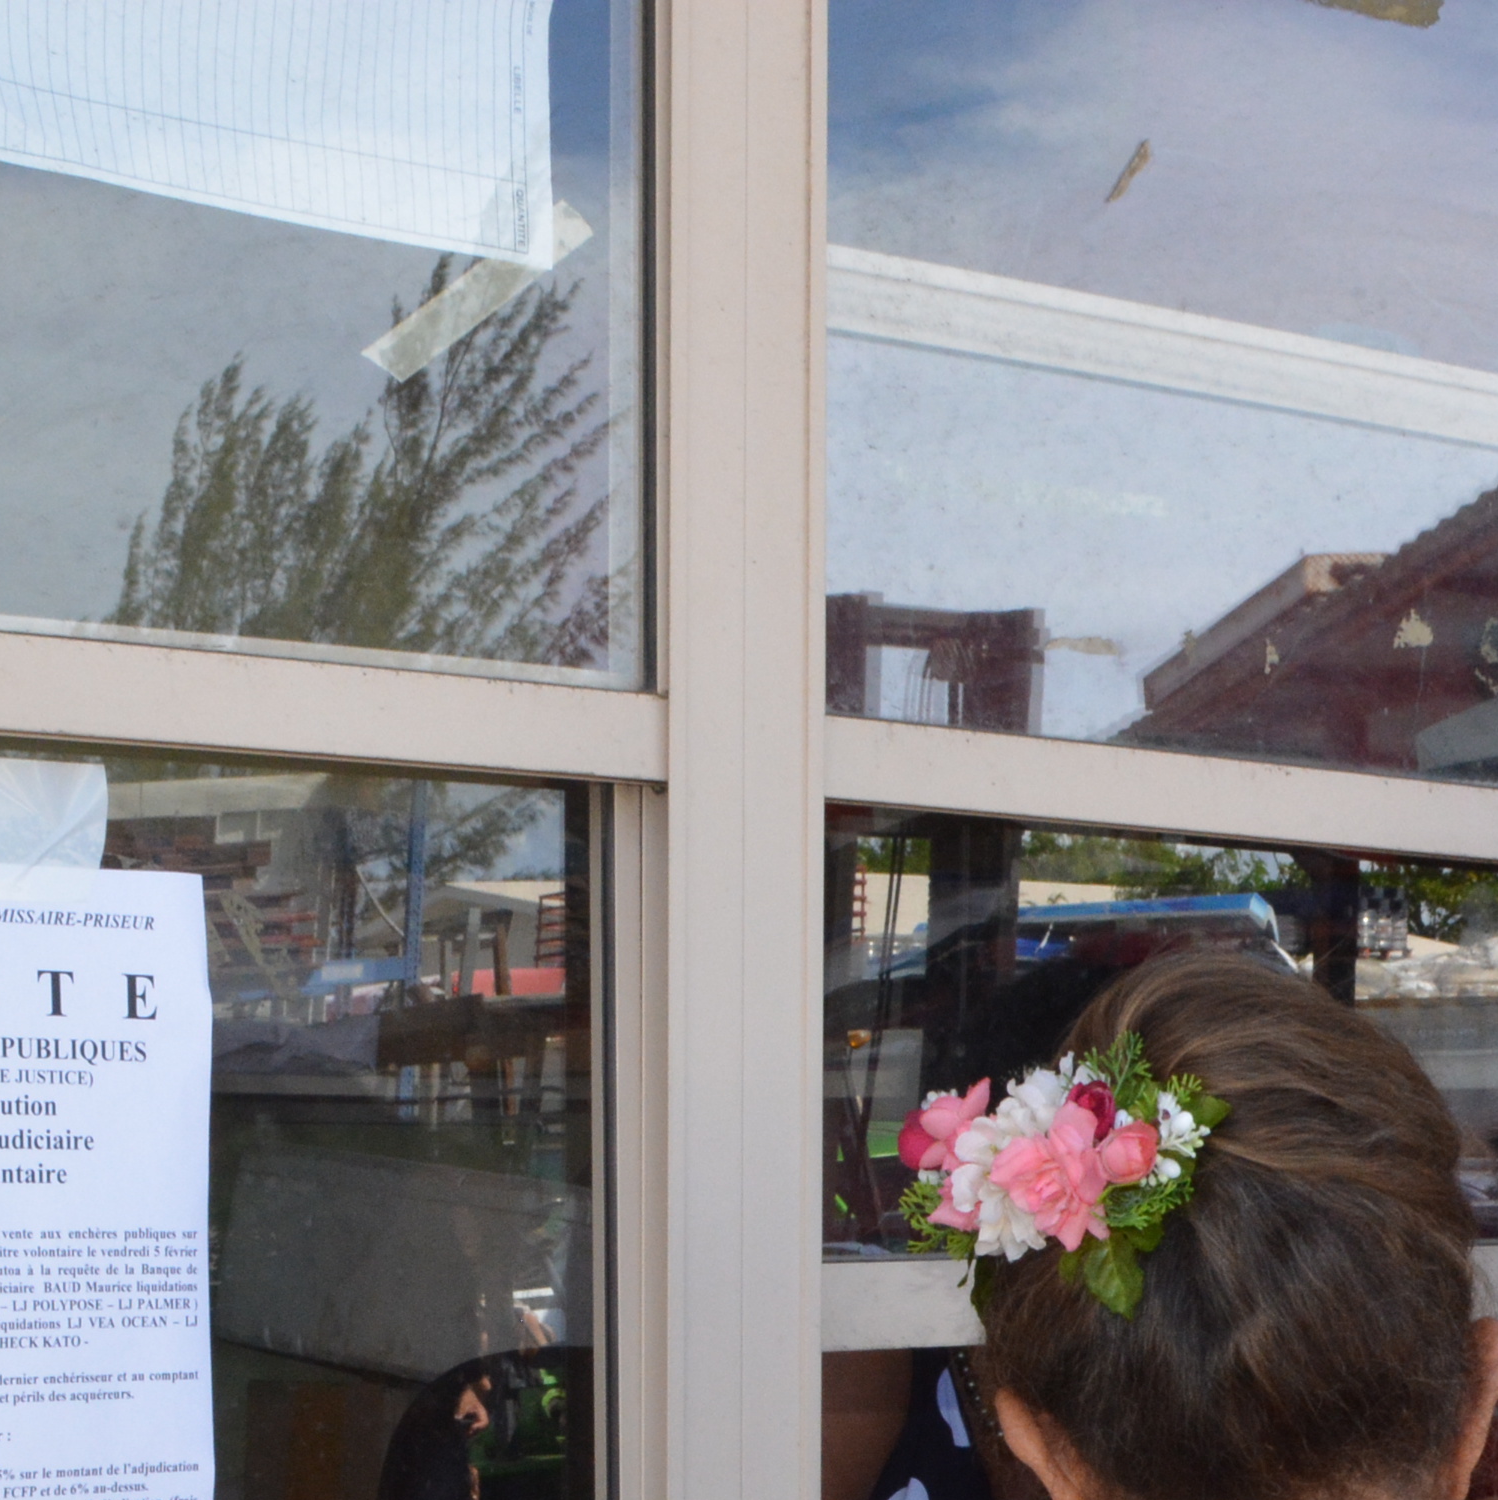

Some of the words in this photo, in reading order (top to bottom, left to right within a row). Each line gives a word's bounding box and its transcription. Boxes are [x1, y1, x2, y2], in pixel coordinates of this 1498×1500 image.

[515, 189, 526, 247] QUANTITE
[1, 1037, 147, 1066] PUBLIQUES
[15, 1069, 94, 1087] JUSTICE)
[1, 1229, 33, 1240] vente
[40, 1230, 62, 1240] aux
[124, 1227, 177, 1243] publiques
[182, 1230, 198, 1240] sur
[23, 1245, 83, 1258] volontaire
[100, 1245, 150, 1258] vendredi
[154, 1245, 161, 1257] 5
[141, 1263, 182, 1278] Banque
[43, 1281, 81, 1294] BAUD
[86, 1281, 133, 1293] Maurice
[136, 1280, 198, 1296] liquidations
[12, 1300, 27, 1312] LJ
[33, 1298, 103, 1312] POLYPOSE
[118, 1298, 133, 1310] LJ
[137, 1298, 191, 1310] PALMER
[67, 1317, 82, 1329] LJ
[88, 1316, 115, 1329] VEA
[121, 1315, 167, 1328] OCEAN
[185, 1315, 198, 1327] LJ
[43, 1335, 81, 1348] KATO
[149, 1370, 199, 1384] comptant
[48, 1390, 67, 1402] des
[19, 1470, 39, 1480] sur
[55, 1466, 103, 1478] montant
[3, 1485, 37, 1499] FCFP
[69, 1483, 89, 1495] 6%
